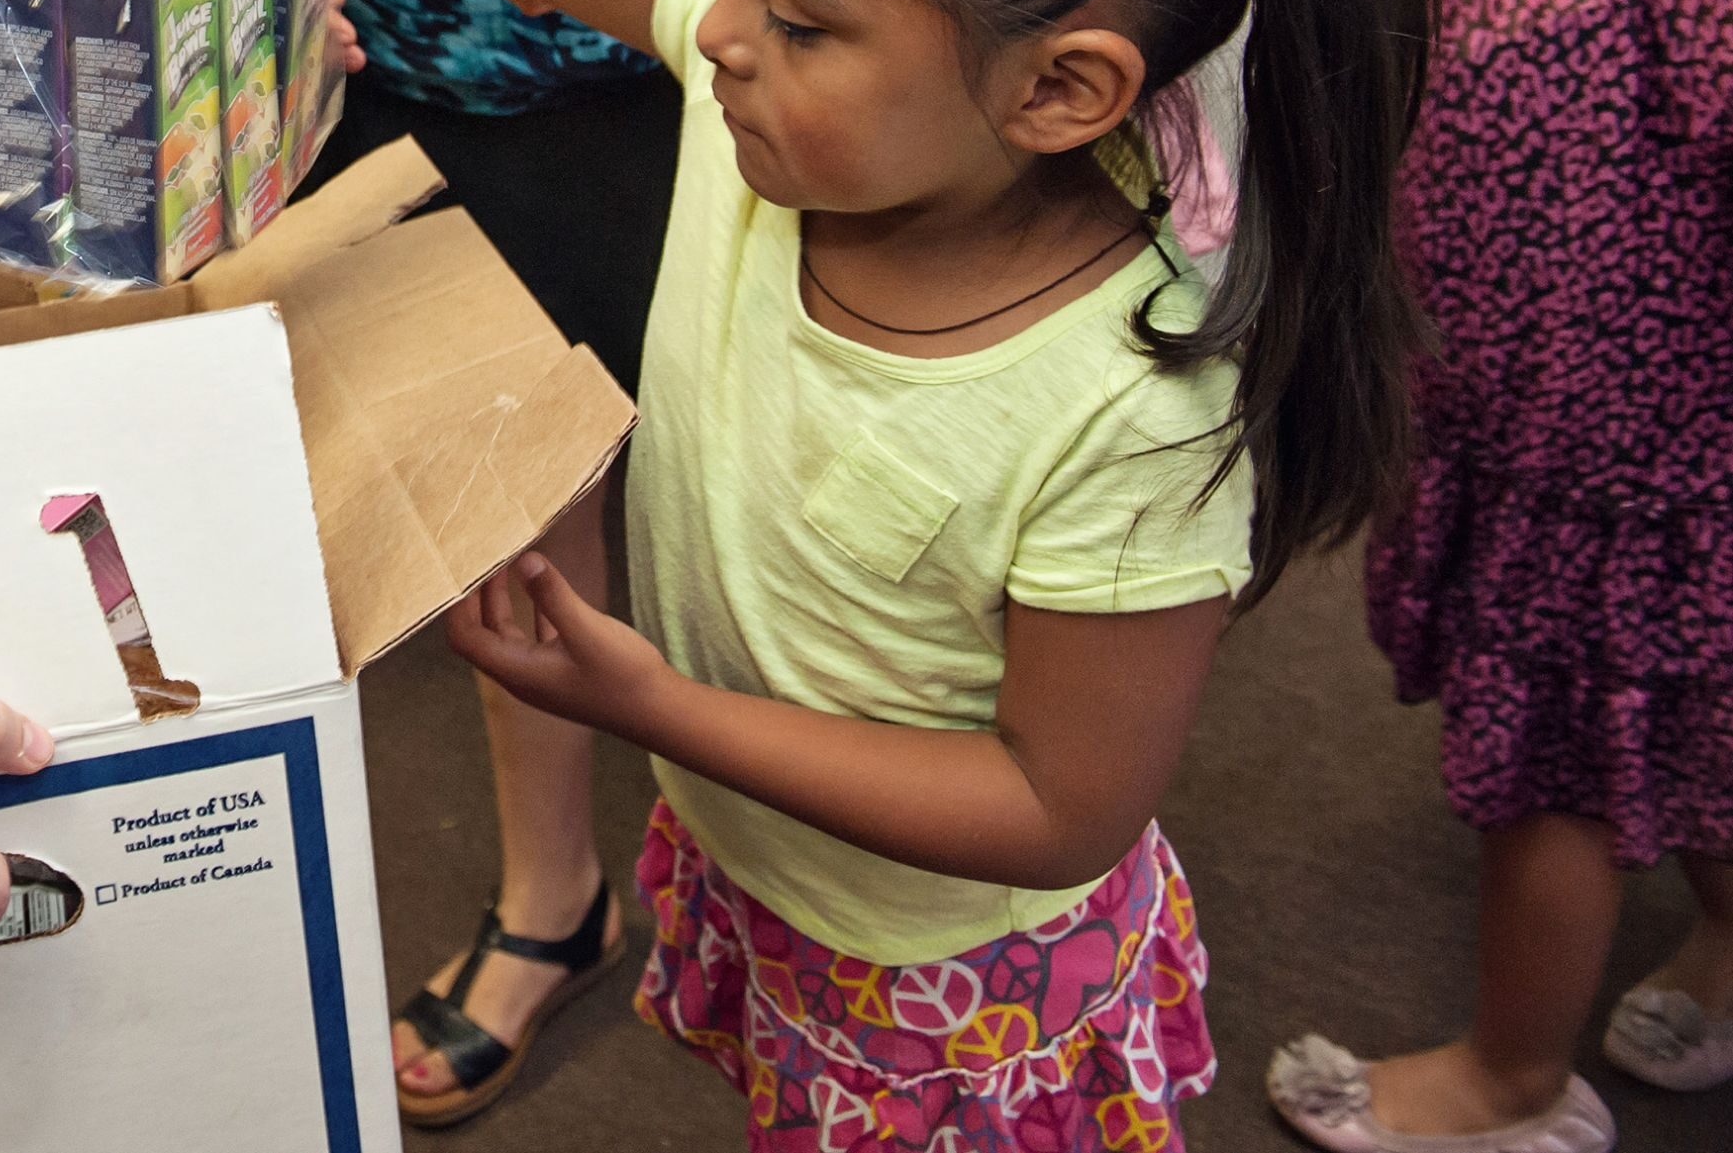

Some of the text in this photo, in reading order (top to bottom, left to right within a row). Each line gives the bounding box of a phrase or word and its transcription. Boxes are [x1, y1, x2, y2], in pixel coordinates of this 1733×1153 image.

[111, 790, 266, 834] Product of USA
[124, 817, 259, 853] unless otherwise
[162, 838, 225, 864] marked
[120, 856, 274, 898] Product of Canada
